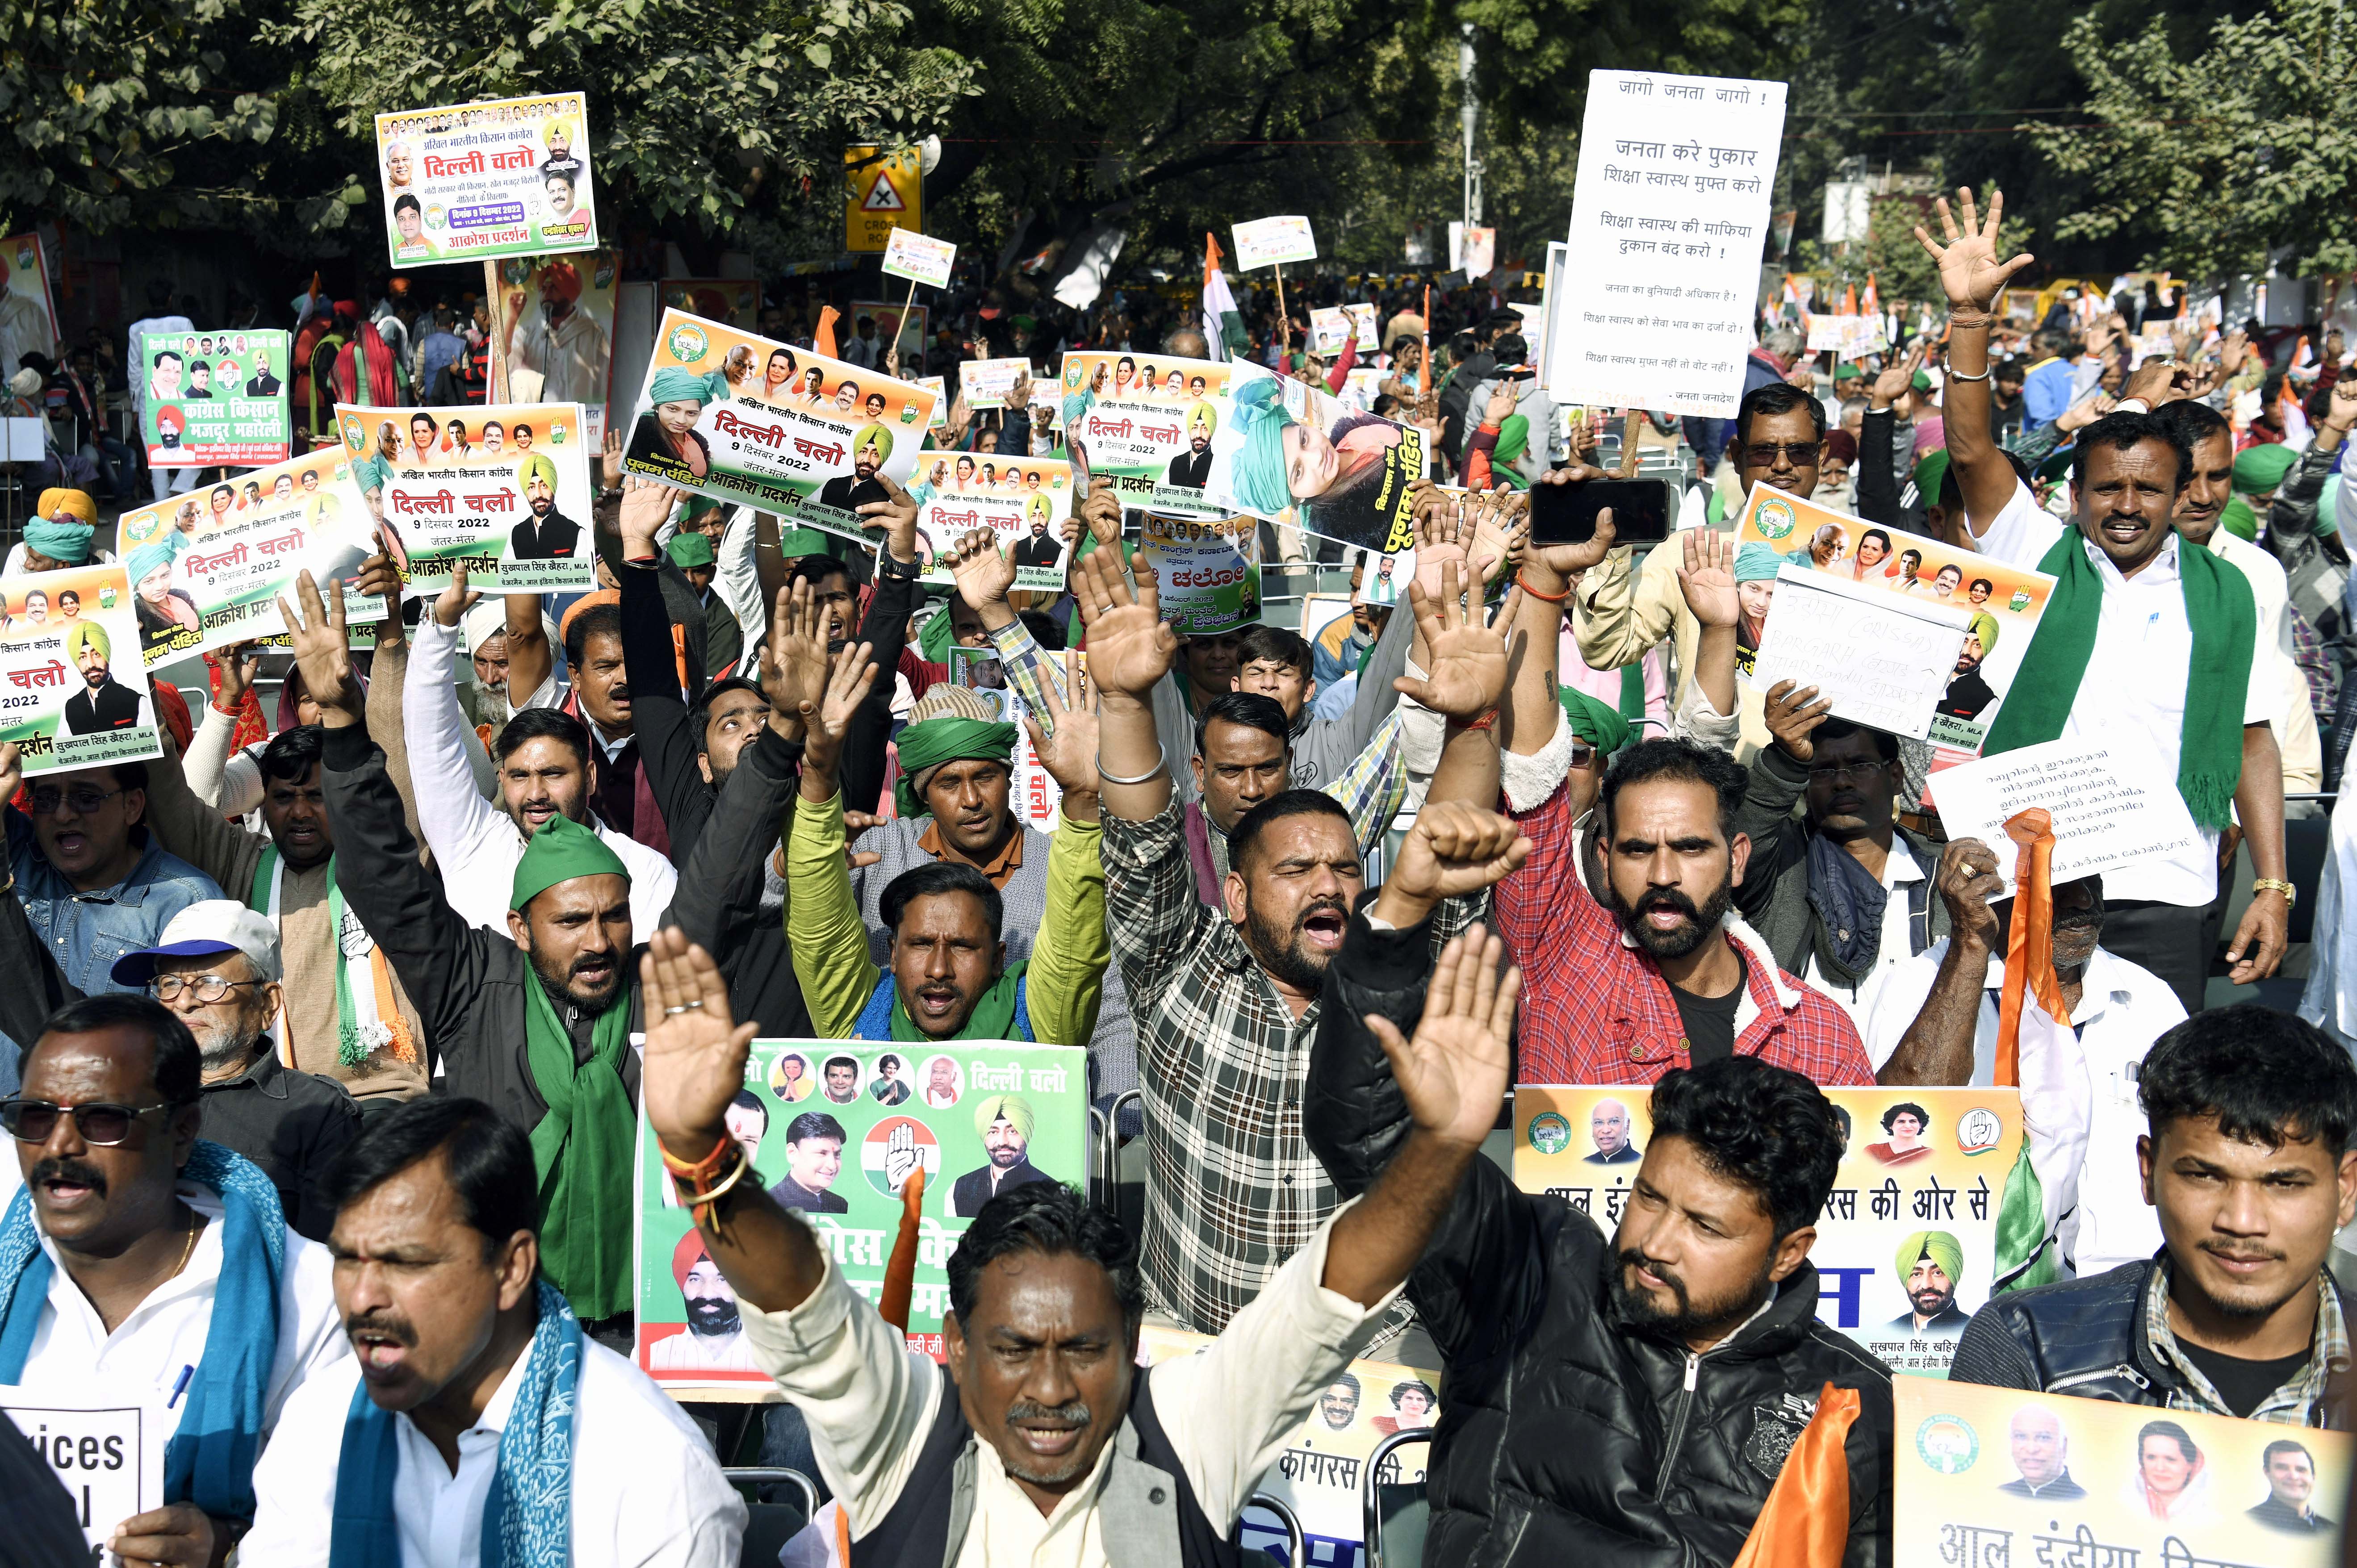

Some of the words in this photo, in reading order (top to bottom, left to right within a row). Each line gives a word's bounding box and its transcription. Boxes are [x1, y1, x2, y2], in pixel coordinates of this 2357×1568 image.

[1620, 78, 1654, 95] जागो
[1665, 85, 1705, 100] जनता
[1716, 86, 1750, 103] जागो
[423, 138, 447, 150] अखिल
[450, 134, 477, 147] भारतीय
[481, 132, 505, 143] किसान
[508, 128, 532, 140] कांग्रेस
[424, 151, 485, 178] दिल्ली
[490, 145, 534, 170] चलो
[1616, 140, 1666, 158] जनता
[1672, 140, 1702, 161] करे
[1709, 148, 1758, 167] पुकार
[1604, 164, 1641, 184] शिक्षा
[1646, 172, 1689, 187] स्वास्थ
[1733, 176, 1761, 193] करो
[502, 205, 521, 213] 2022
[1600, 211, 1633, 229] शिक्षा
[1638, 218, 1677, 231] स्वास्थ
[1682, 218, 1700, 233] की
[1704, 221, 1752, 238] माफिया
[449, 231, 489, 247] आक्रोश
[493, 226, 528, 243] प्रदर्शन
[1620, 239, 1657, 254] दुकान
[1662, 241, 1680, 256] बंद
[1685, 242, 1711, 257] करो
[1606, 284, 1629, 293] जनता
[1647, 285, 1682, 297] बुनियादी
[1685, 288, 1720, 300] अधिकार
[1724, 290, 1729, 301] है
[1584, 312, 1605, 323] शिक्षा
[1609, 316, 1633, 325] स्वास्थ
[1637, 316, 1649, 326] को
[1652, 317, 1669, 327] सेवा
[1672, 320, 1688, 329] भाव
[1707, 322, 1725, 332] दर्जा
[1727, 322, 1737, 333] दो
[1586, 351, 1607, 363] शिक्षा
[1611, 355, 1635, 364] स्वास्थ
[1680, 359, 1690, 369] तो
[1693, 360, 1707, 370] वोट
[229, 397, 280, 418] किसान
[1676, 392, 1699, 400] जनता
[1703, 393, 1734, 403] जनादेश
[738, 397, 765, 410] अखिल
[768, 406, 797, 420] भारतीय
[799, 414, 826, 429] किसान
[828, 423, 853, 436] कांग्रेस
[715, 410, 786, 448] दिल्ली
[794, 438, 846, 466] चलो
[1088, 416, 1134, 438] दिल्ली
[1140, 424, 1181, 444] चलो
[650, 452, 674, 464] किसान
[743, 443, 775, 460] दिसंबर
[777, 456, 810, 471] 2022
[627, 458, 663, 472] पूनम
[666, 467, 706, 487] पंडित
[744, 461, 789, 480] जंतर-मंतर
[710, 471, 759, 495] आक्रोश
[761, 485, 803, 508] प्रदर्शन
[1122, 474, 1155, 494] प्रदर्शन
[392, 489, 455, 514] दिल्ली
[464, 487, 515, 512] चलो
[802, 502, 831, 515] सुखपाल
[832, 509, 846, 519] सिंह
[414, 520, 420, 528] 9
[425, 518, 453, 529] दिसंबर
[458, 519, 490, 527] 2022
[833, 522, 847, 531] इंडिया
[848, 527, 865, 537] किसान
[931, 507, 980, 527] दिल्ली
[985, 514, 1022, 531] चलो
[431, 534, 477, 546] जंतर-मंतर
[185, 543, 248, 577] दिल्ली
[257, 528, 305, 555] चलो
[501, 564, 529, 574] सुखपाल
[532, 561, 546, 571] सिंह
[204, 602, 246, 629] आक्रोश
[0, 641, 30, 654] किसान
[34, 639, 60, 649] कांग्रेस
[7, 660, 66, 690] चलो
[2, 695, 39, 708] 2022
[1967, 728, 1982, 736] MLA
[1030, 774, 1052, 820] चलो
[970, 1062, 1023, 1092] दिल्ली
[1030, 1067, 1067, 1093] चलो
[1870, 1177, 1900, 1221] की
[1913, 1175, 1956, 1221] ओर
[1970, 1175, 1989, 1221] से
[927, 1334, 942, 1354] जी
[1869, 1342, 1905, 1355] सुखपाल
[1910, 1339, 1928, 1352] सिंह
[1908, 1358, 1919, 1367] आल
[1922, 1355, 1939, 1369] इंडीया
[1280, 1439, 1361, 1490] कांगरस
